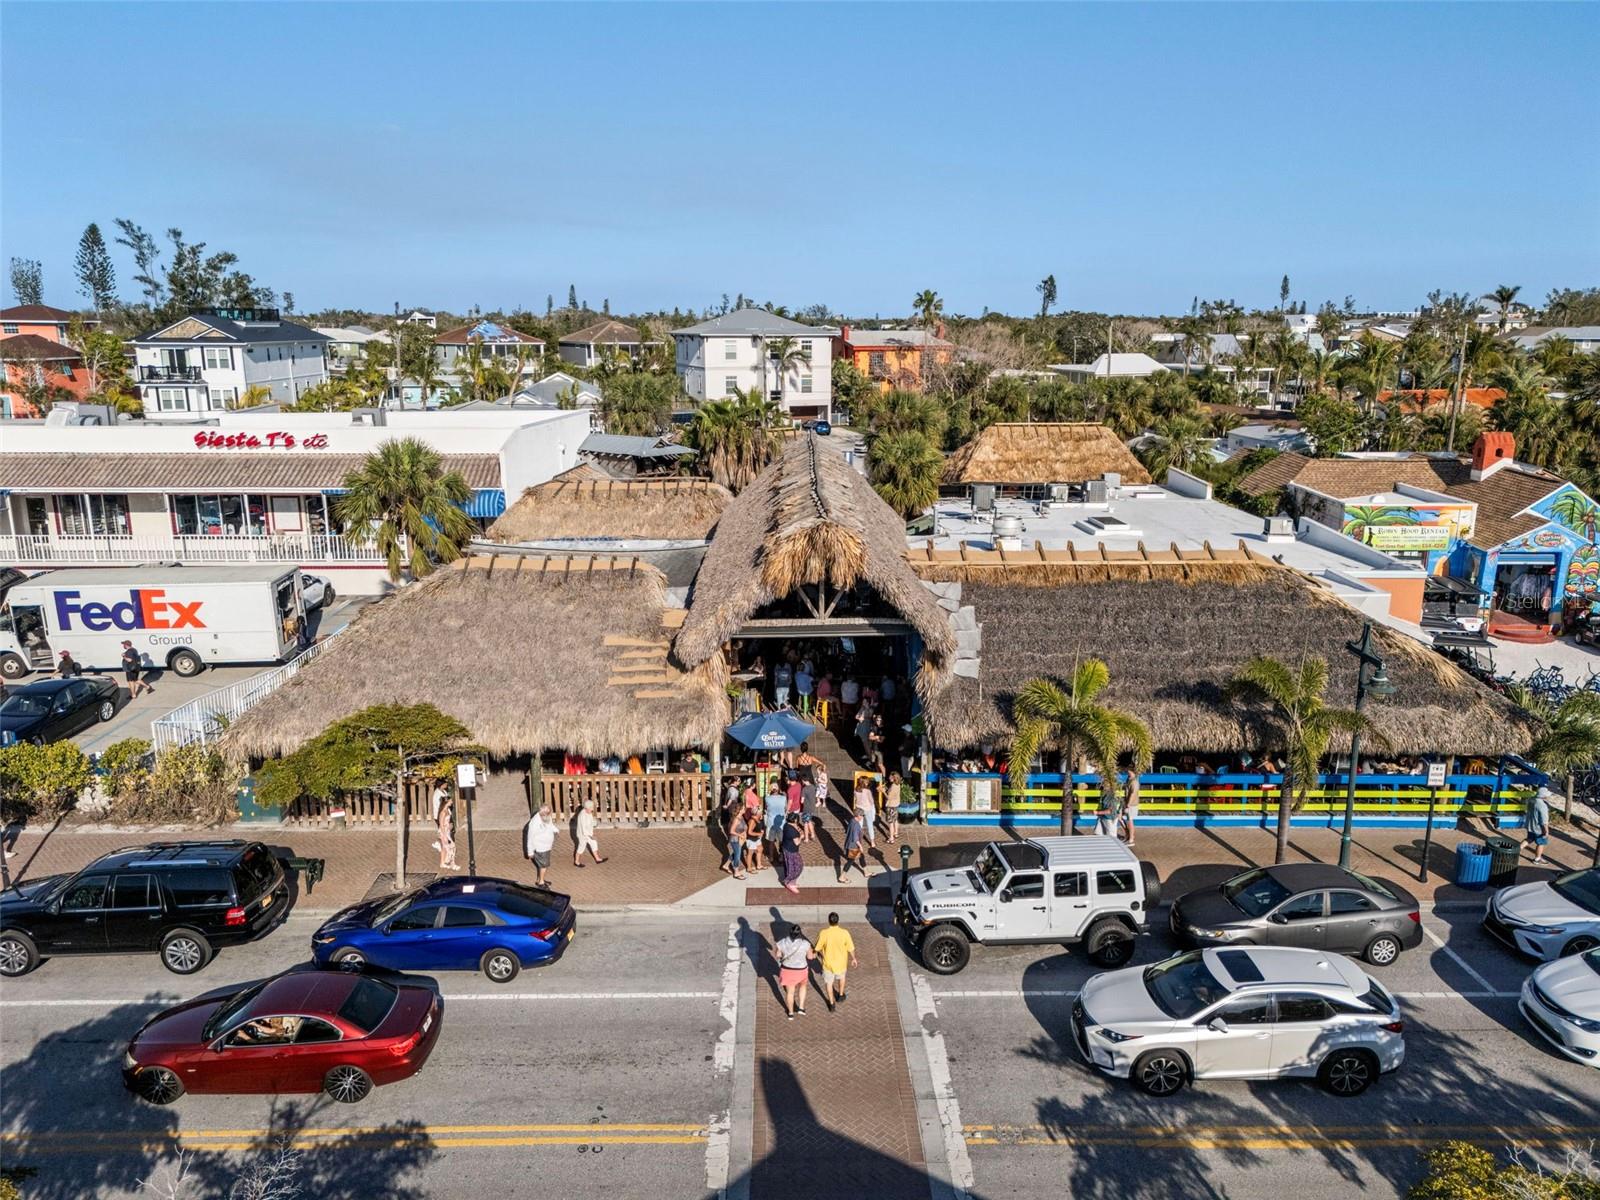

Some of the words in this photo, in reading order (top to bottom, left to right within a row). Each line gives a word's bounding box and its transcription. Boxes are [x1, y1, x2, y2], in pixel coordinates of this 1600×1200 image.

[194, 431, 261, 448] Siesta
[266, 432, 296, 449] T's
[303, 433, 329, 448] etc
[53, 589, 208, 631] FedEx
[149, 634, 193, 646] Ground
[761, 734, 787, 742] Corona
